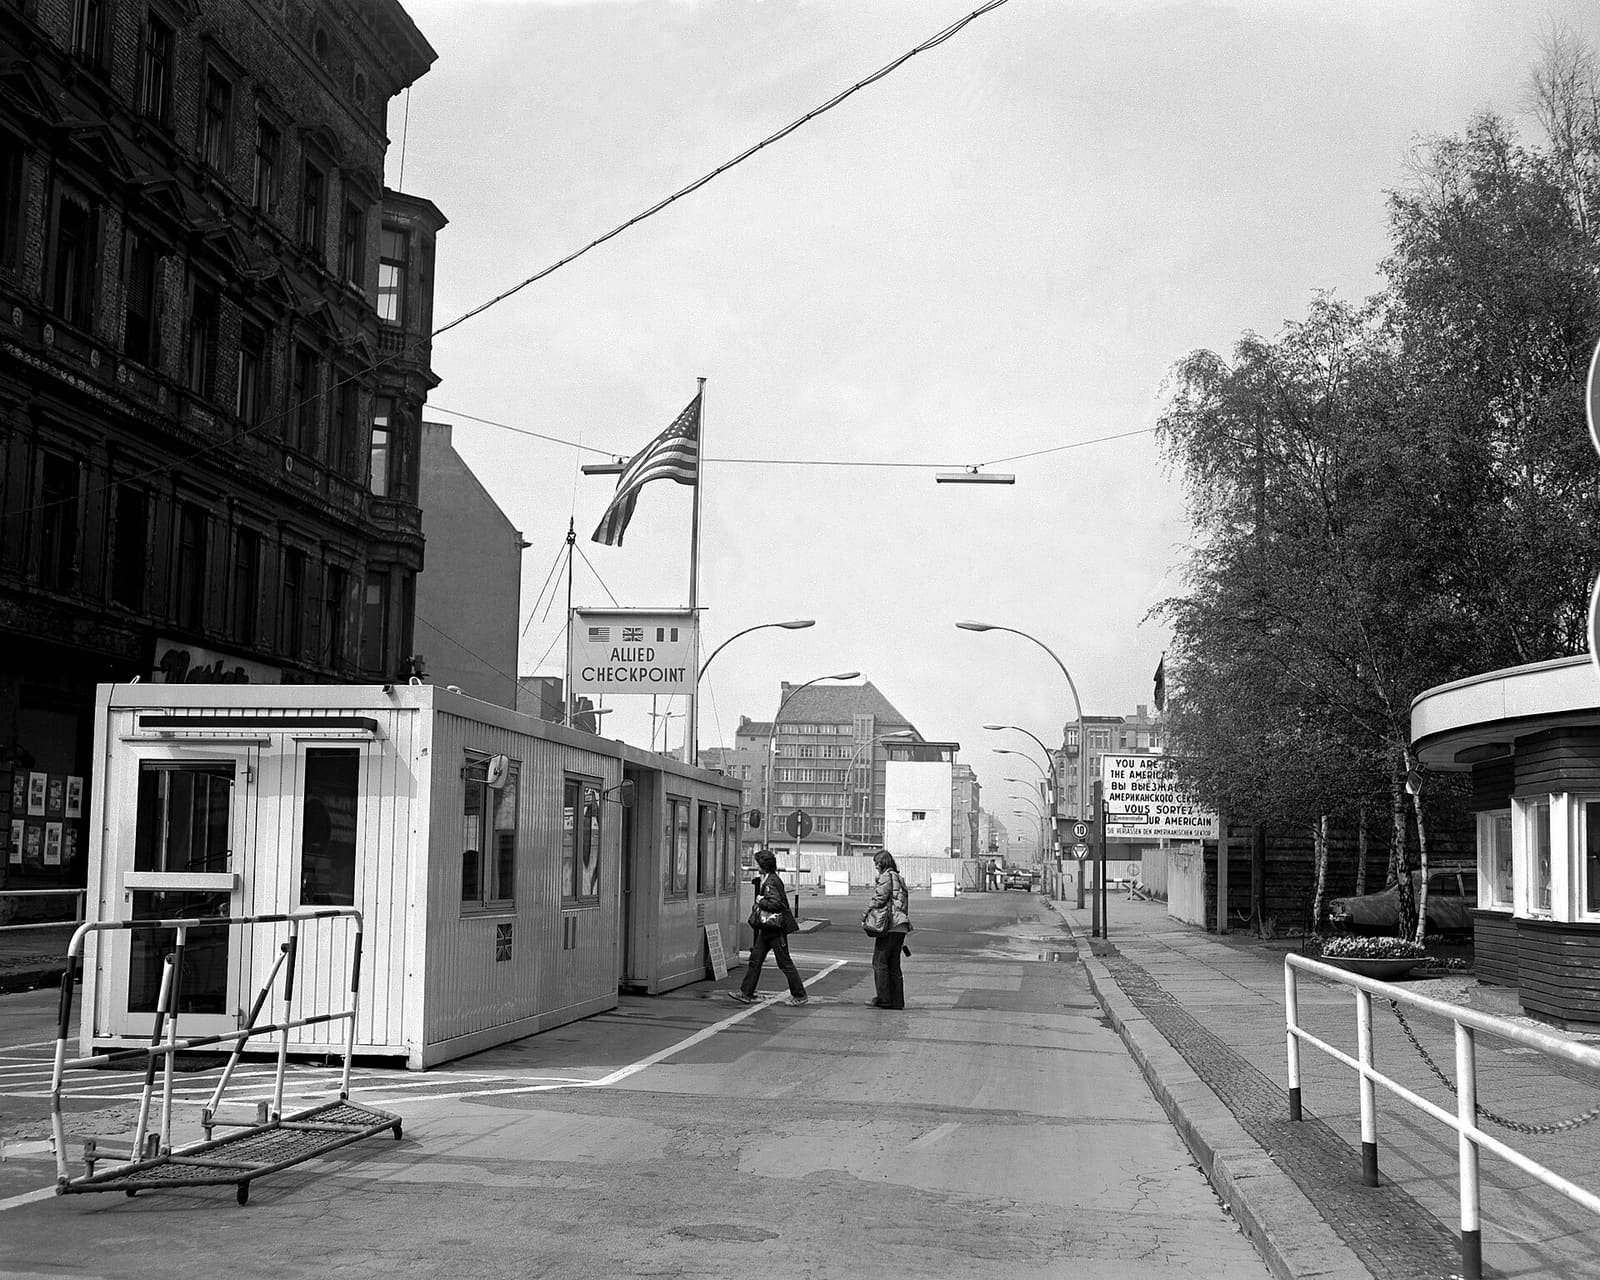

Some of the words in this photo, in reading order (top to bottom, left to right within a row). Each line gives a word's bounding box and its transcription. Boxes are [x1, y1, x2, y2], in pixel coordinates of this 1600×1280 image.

[610, 647, 655, 662] ALLIED
[581, 666, 686, 682] CHECKPOINT
[1115, 759, 1135, 768] YOU
[1140, 759, 1159, 769] ARE
[1110, 770, 1125, 779] THE
[1111, 781, 1126, 791] ВЫ
[1124, 804, 1151, 814] VOUS
[1156, 805, 1193, 815] SORTEZ
[1165, 816, 1212, 827] AMERICAIN
[1077, 825, 1085, 835] 10
